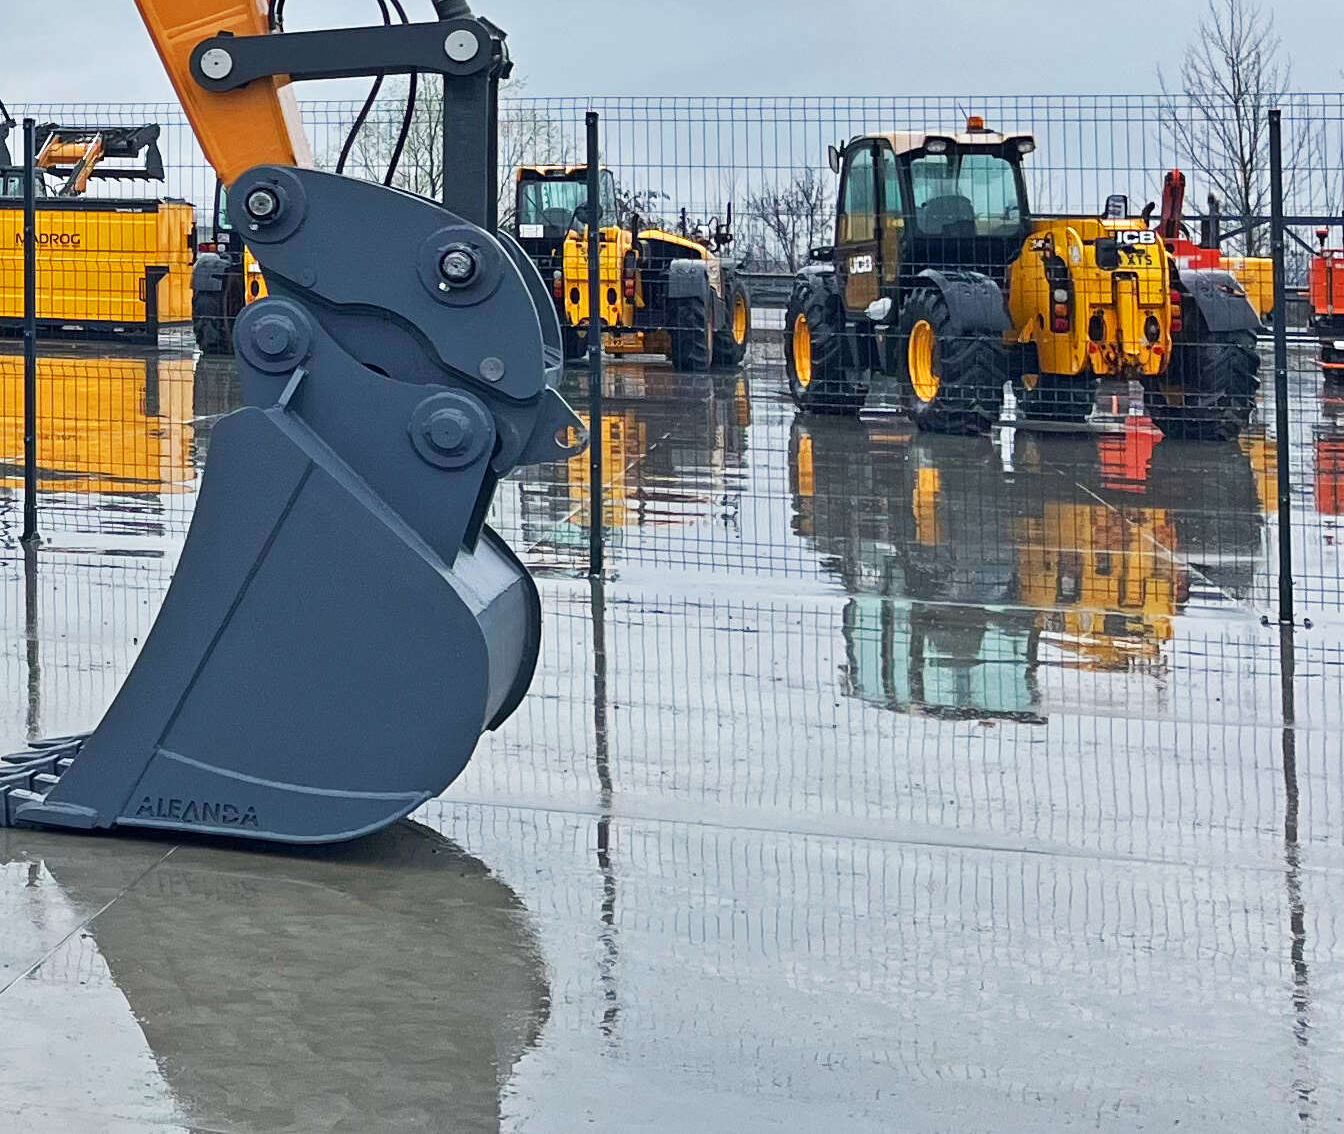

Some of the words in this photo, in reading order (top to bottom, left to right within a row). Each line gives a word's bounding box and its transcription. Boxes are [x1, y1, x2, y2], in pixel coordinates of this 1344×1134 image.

[15, 233, 81, 245] MDROG
[849, 255, 873, 274] JCB
[135, 796, 260, 827] ALEANDA
